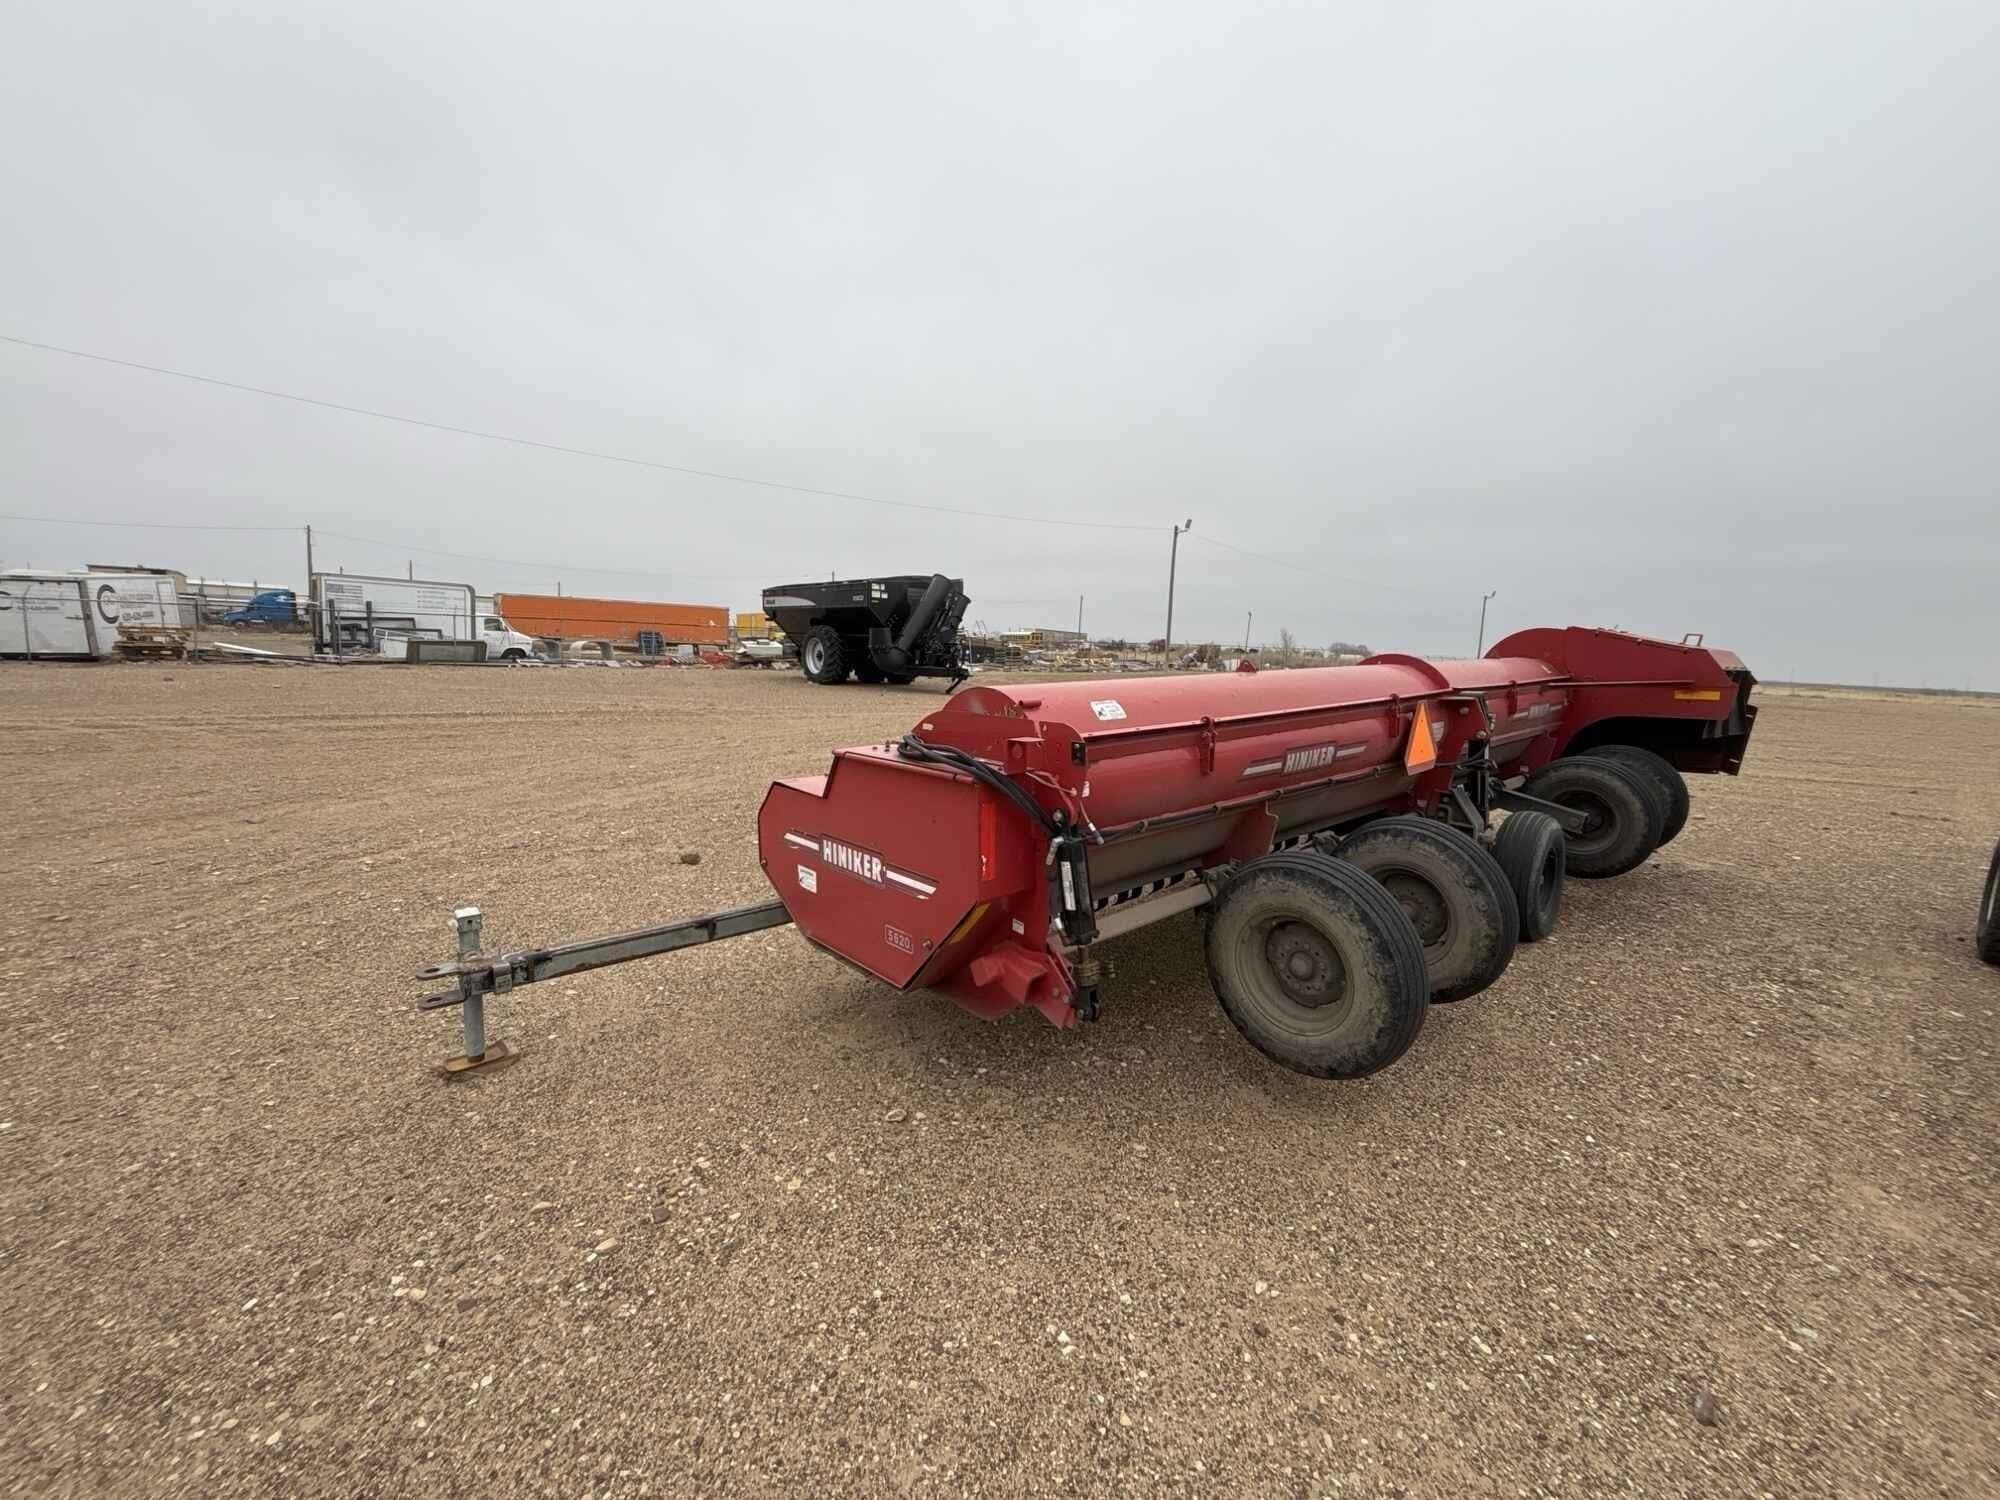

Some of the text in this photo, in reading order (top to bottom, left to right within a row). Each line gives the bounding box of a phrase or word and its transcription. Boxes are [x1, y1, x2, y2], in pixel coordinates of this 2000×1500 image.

[1284, 746, 1335, 773] HINIKER
[823, 839, 882, 883] HINIKER
[888, 930, 911, 949] 5620
